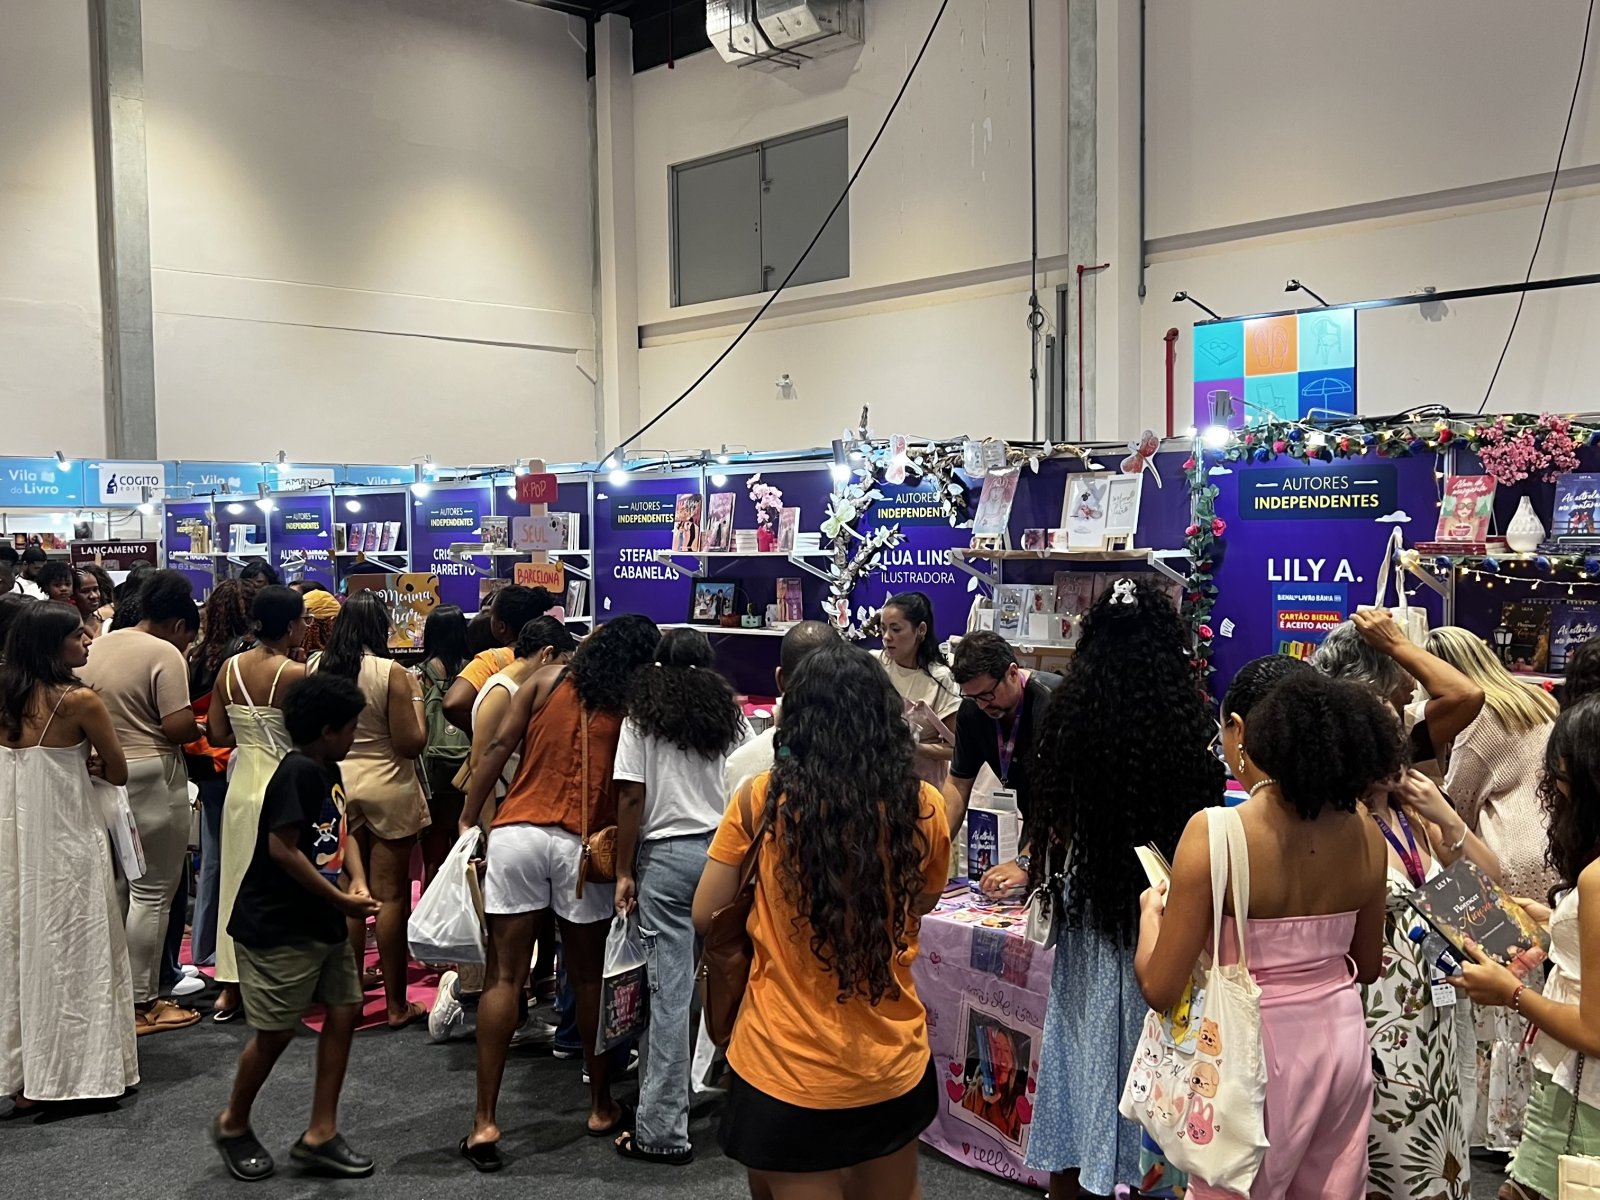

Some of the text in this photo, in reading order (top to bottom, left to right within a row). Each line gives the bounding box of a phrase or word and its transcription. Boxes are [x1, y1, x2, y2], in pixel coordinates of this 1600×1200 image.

[9, 469, 37, 481] Vila
[201, 474, 225, 485] Vila
[367, 476, 388, 485] Vila
[119, 476, 159, 486] COGITO
[1282, 475, 1349, 491] AUTORES
[10, 482, 59, 495] do Livro
[1561, 489, 1600, 503] As estrela
[630, 501, 661, 511] AUTORES
[1254, 494, 1379, 510] INDEPENDENTES
[440, 507, 464, 516] AUTORES
[430, 518, 474, 527] INDEPENDENTES
[618, 513, 675, 523] INDEPENDENTES
[522, 524, 549, 544] SEUL
[81, 545, 147, 556] LANÇAMENTO
[883, 550, 952, 566] LUA LINS
[613, 565, 680, 580] CABANELAS
[1267, 559, 1363, 583] LILY A.
[517, 569, 560, 586] BARCELONA
[881, 571, 955, 584] ILUSTRADORA
[1279, 612, 1339, 621] CARTÃO BIENAL
[1286, 621, 1314, 629] ACEITO
[1557, 624, 1568, 635] As
